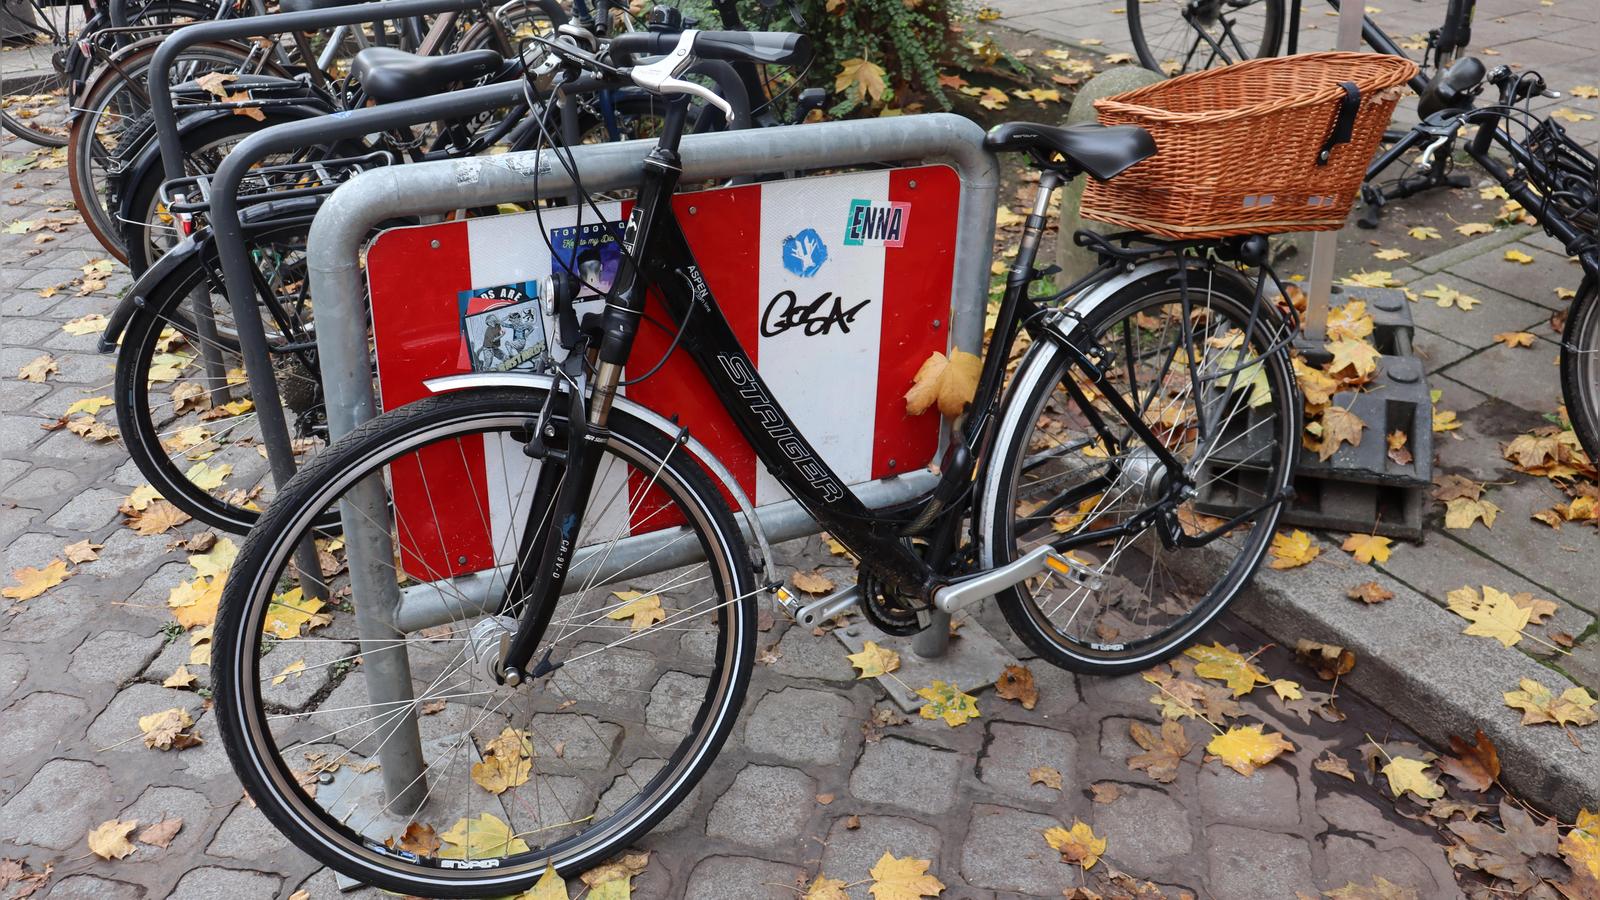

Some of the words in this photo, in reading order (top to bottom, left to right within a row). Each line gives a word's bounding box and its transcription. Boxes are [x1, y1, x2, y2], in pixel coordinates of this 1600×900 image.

[850, 206, 903, 241] ENNA
[500, 288, 522, 302] ARE
[687, 265, 709, 298] ASPEN
[717, 352, 844, 503] STAIGER
